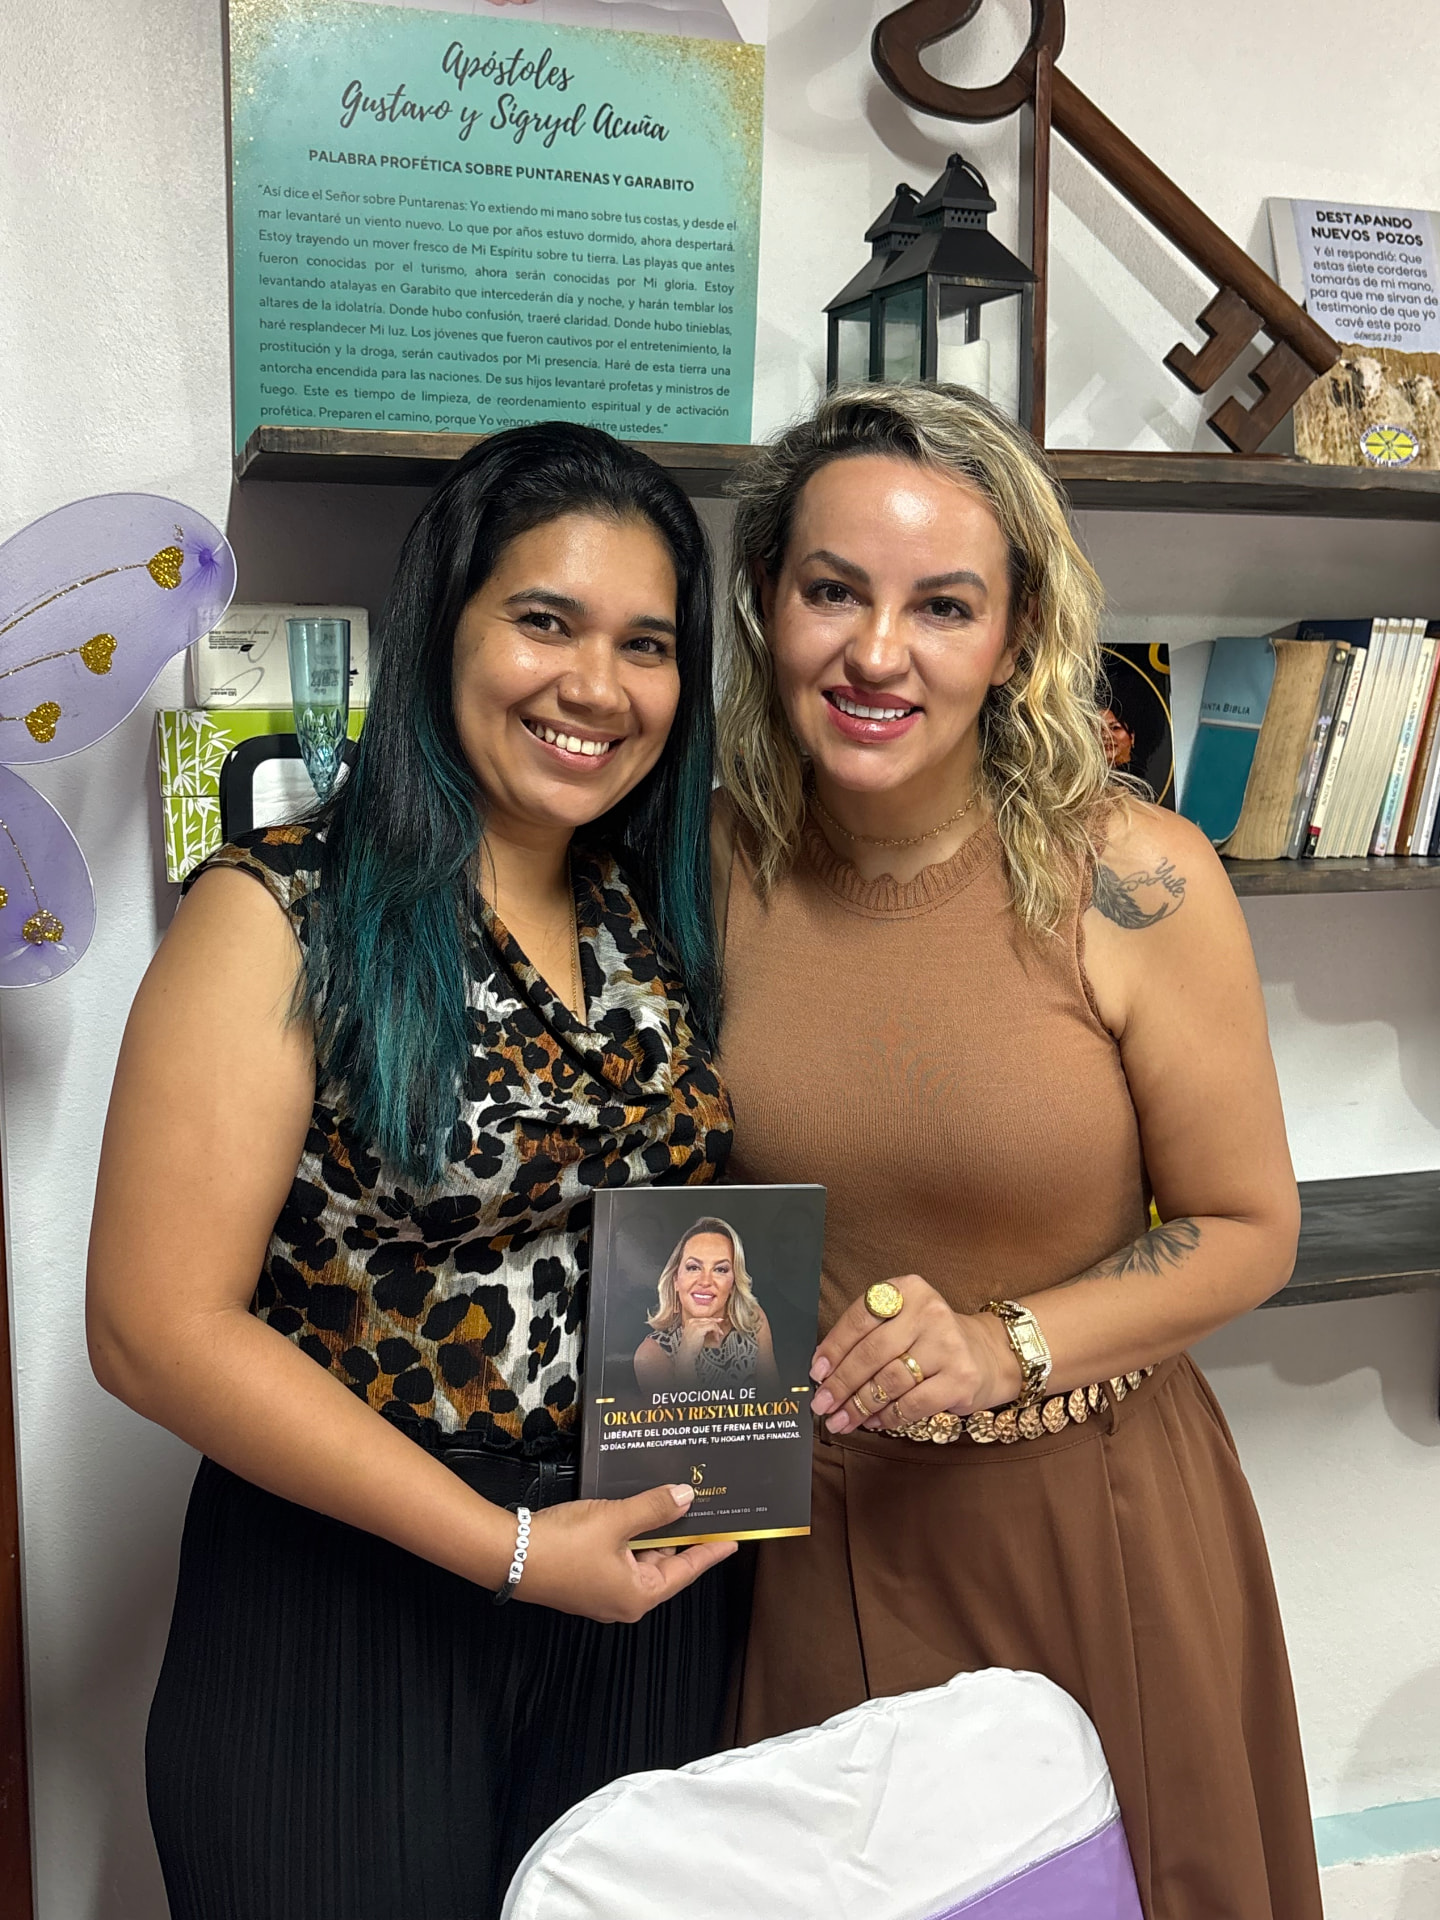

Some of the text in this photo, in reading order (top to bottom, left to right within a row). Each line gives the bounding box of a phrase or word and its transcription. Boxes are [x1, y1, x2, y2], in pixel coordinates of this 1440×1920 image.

[442, 42, 574, 91] Apóstoles
[340, 80, 670, 148] Gustavo y Sigryd Acuña
[309, 150, 694, 192] PALABRA PROFÉTICA SOBRE PUNTARENAS Y GARABITO
[282, 186, 310, 199] dice
[310, 189, 323, 200] el
[324, 189, 361, 203] Señor
[362, 193, 396, 206] sobre
[398, 194, 468, 211] Puntarenas:
[468, 199, 486, 212] Yo
[486, 203, 538, 216] extiendo
[539, 206, 555, 217] mi
[556, 209, 589, 220] mano
[590, 209, 623, 223] sobre
[624, 212, 642, 224] tus
[642, 215, 681, 228] costas,
[682, 218, 690, 230] y
[690, 217, 725, 230] desde
[725, 219, 737, 231] el
[1316, 210, 1412, 229] DESTAPANDO
[257, 208, 736, 252] mar levantaré un viento nuevo. Lo que por años estuvo dormido, ahora despertará.
[1311, 226, 1423, 246] NUEVOS POZOS
[258, 228, 736, 273] Estoy trayendo un mover fresco de Mi Espíritu sobre tu tierra. Las playas que antes
[1314, 246, 1422, 264] Y él respondió: Que
[258, 251, 735, 296] fueron conocidas por el turismo, ahora serán conocidas por Mi gloria. Estoy
[1313, 260, 1428, 278] estas siete corderas
[1311, 274, 1434, 293] tomarás de mi mano,
[1310, 288, 1439, 306] para que me sirvan de
[1316, 302, 1436, 322] testimonio de que yo
[1335, 317, 1421, 333] cavé este pozo
[260, 404, 316, 417] profética.
[318, 406, 373, 421] Preparen
[374, 409, 386, 420] el
[386, 411, 433, 424] camino,
[434, 414, 477, 429] porque
[478, 413, 495, 426] Yo
[1222, 702, 1250, 715] BIBLIA
[652, 1388, 756, 1404] DEVOCIONAL DE
[604, 1397, 800, 1426] ORACIÓN Y RESTAURACIÓN
[604, 1420, 798, 1440] LIBÉRATE DEL DOLOR QUE TE FRENA EN LA VIDA.
[610, 1442, 626, 1451] DÍAS
[627, 1441, 645, 1449] PARA
[646, 1438, 686, 1448] RECUPERAR
[698, 1437, 709, 1445] FE,
[721, 1435, 745, 1443] HOGAR
[766, 1431, 801, 1440] FINANZAS.
[693, 1486, 727, 1496] Santos
[512, 1514, 529, 1574] FAITH
